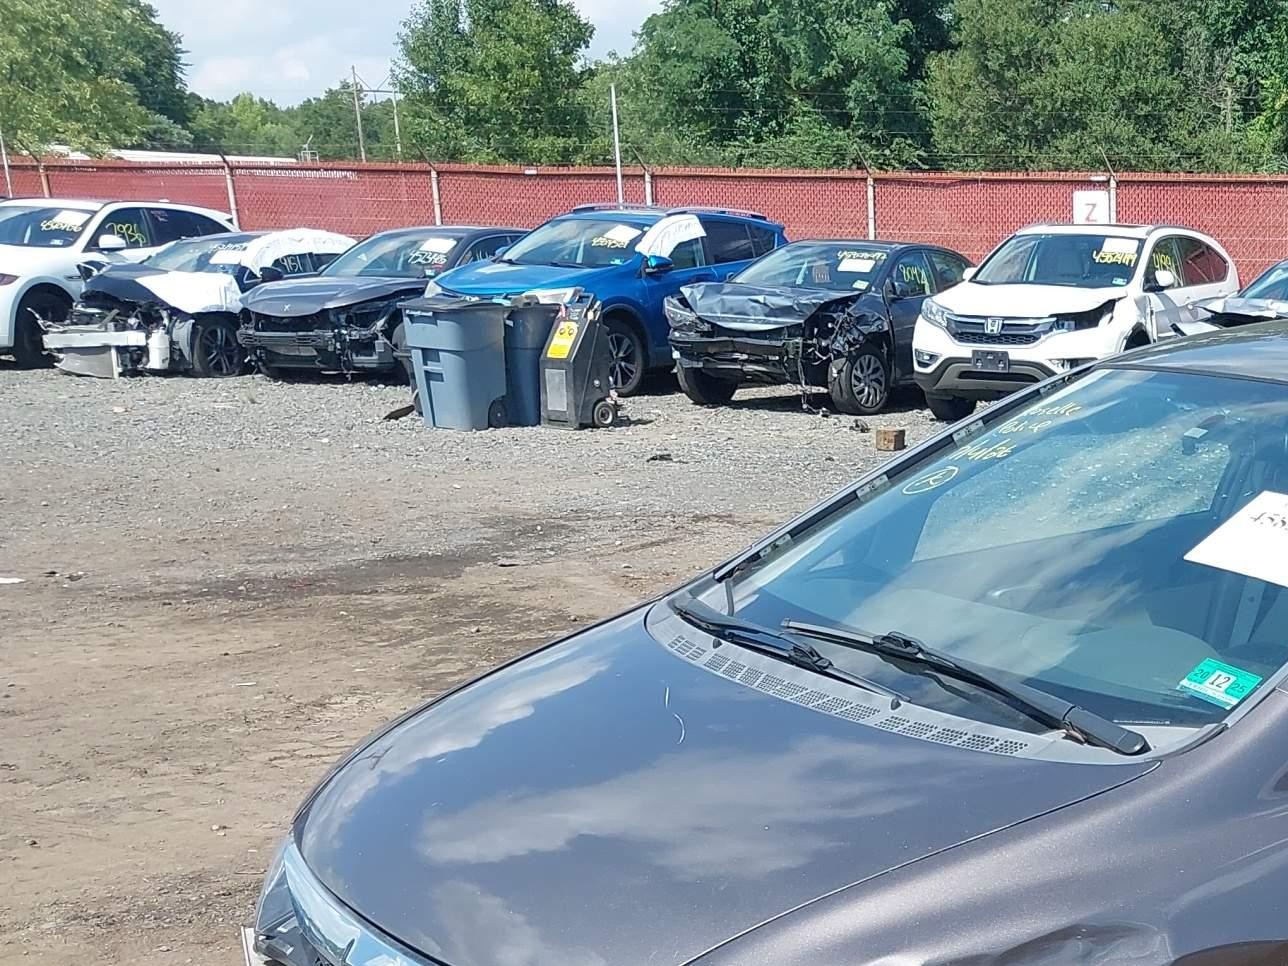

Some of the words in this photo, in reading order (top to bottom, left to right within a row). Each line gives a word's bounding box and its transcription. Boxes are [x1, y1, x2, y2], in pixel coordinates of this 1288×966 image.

[1195, 669, 1210, 680] 20
[1208, 673, 1231, 689] 12
[1231, 682, 1249, 694] 25
